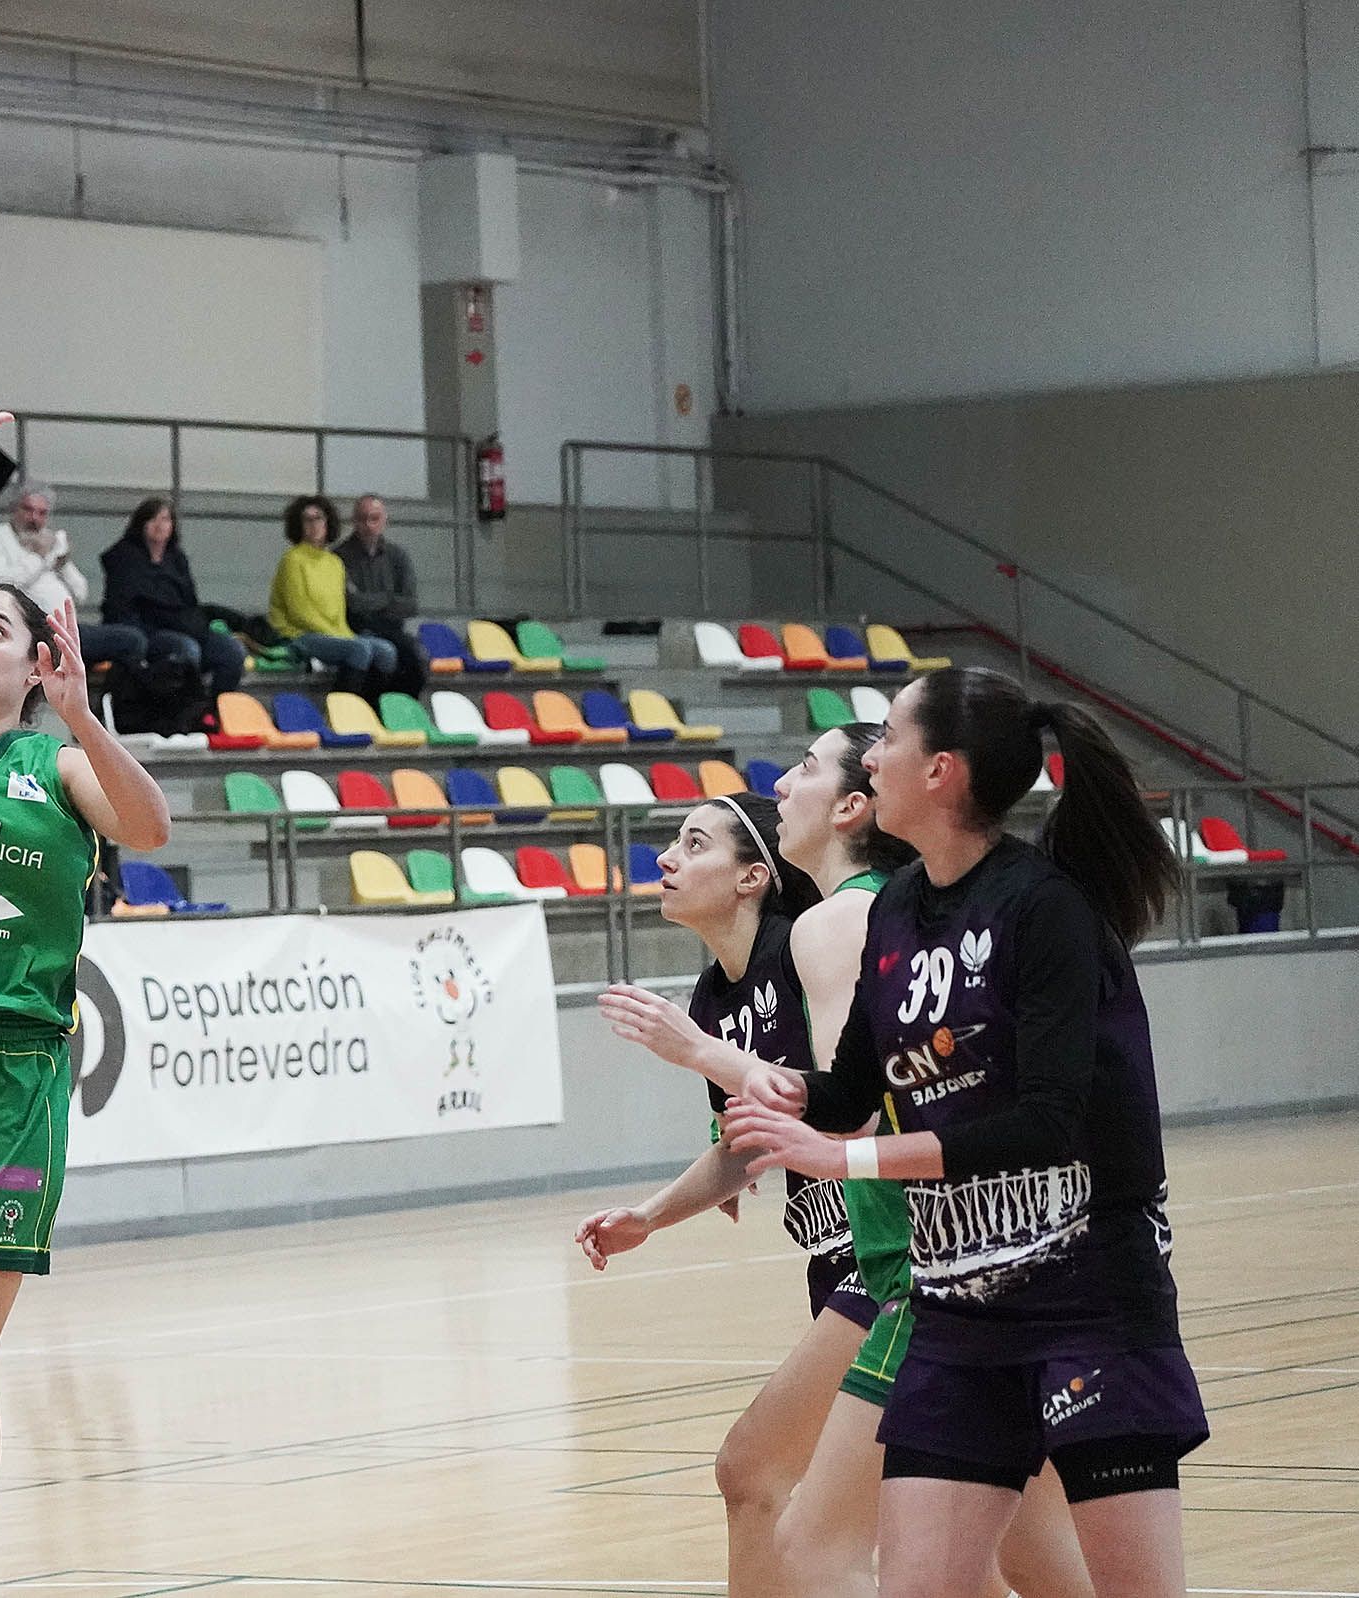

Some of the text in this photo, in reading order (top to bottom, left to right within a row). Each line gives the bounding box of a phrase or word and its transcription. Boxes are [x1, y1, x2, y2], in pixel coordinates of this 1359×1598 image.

[141, 957, 365, 1037] Deputación
[897, 945, 955, 1025] 39
[149, 1026, 369, 1090] Pontevedra
[885, 1044, 941, 1087] GN
[911, 1069, 987, 1107] BASQUET
[1050, 1391, 1102, 1427] BASQUET
